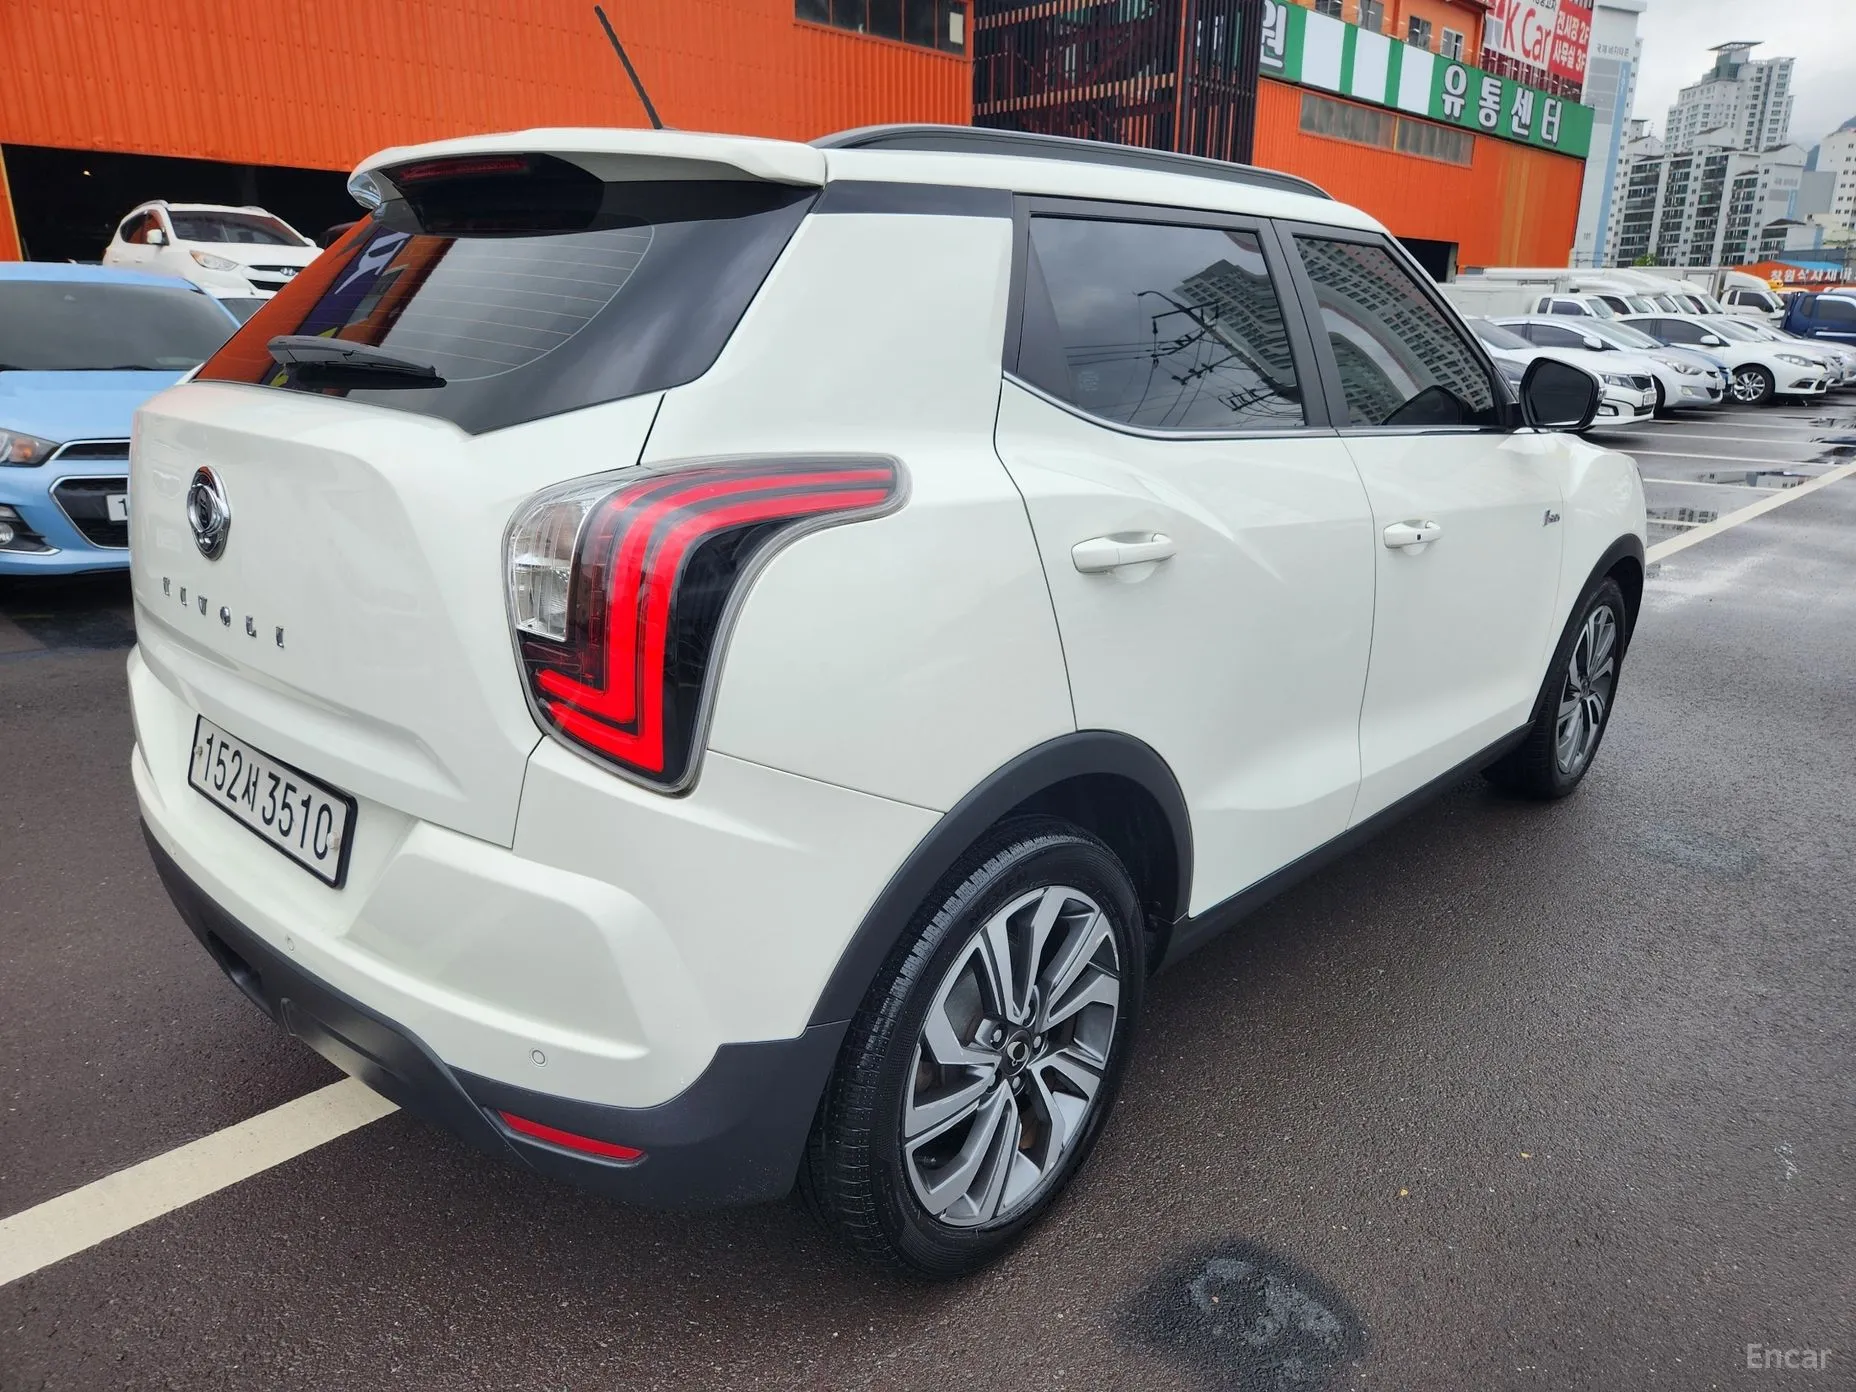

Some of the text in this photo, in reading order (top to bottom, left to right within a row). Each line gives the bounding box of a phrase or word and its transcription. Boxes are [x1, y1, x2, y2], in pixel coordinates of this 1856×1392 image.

[1502, 0, 1552, 65] K Car
[1553, 39, 1587, 73] 사무실 3F
[1556, 10, 1591, 45] 전시장 2F
[1441, 63, 1562, 144] 유통센터
[162, 576, 285, 649] TIVOLI
